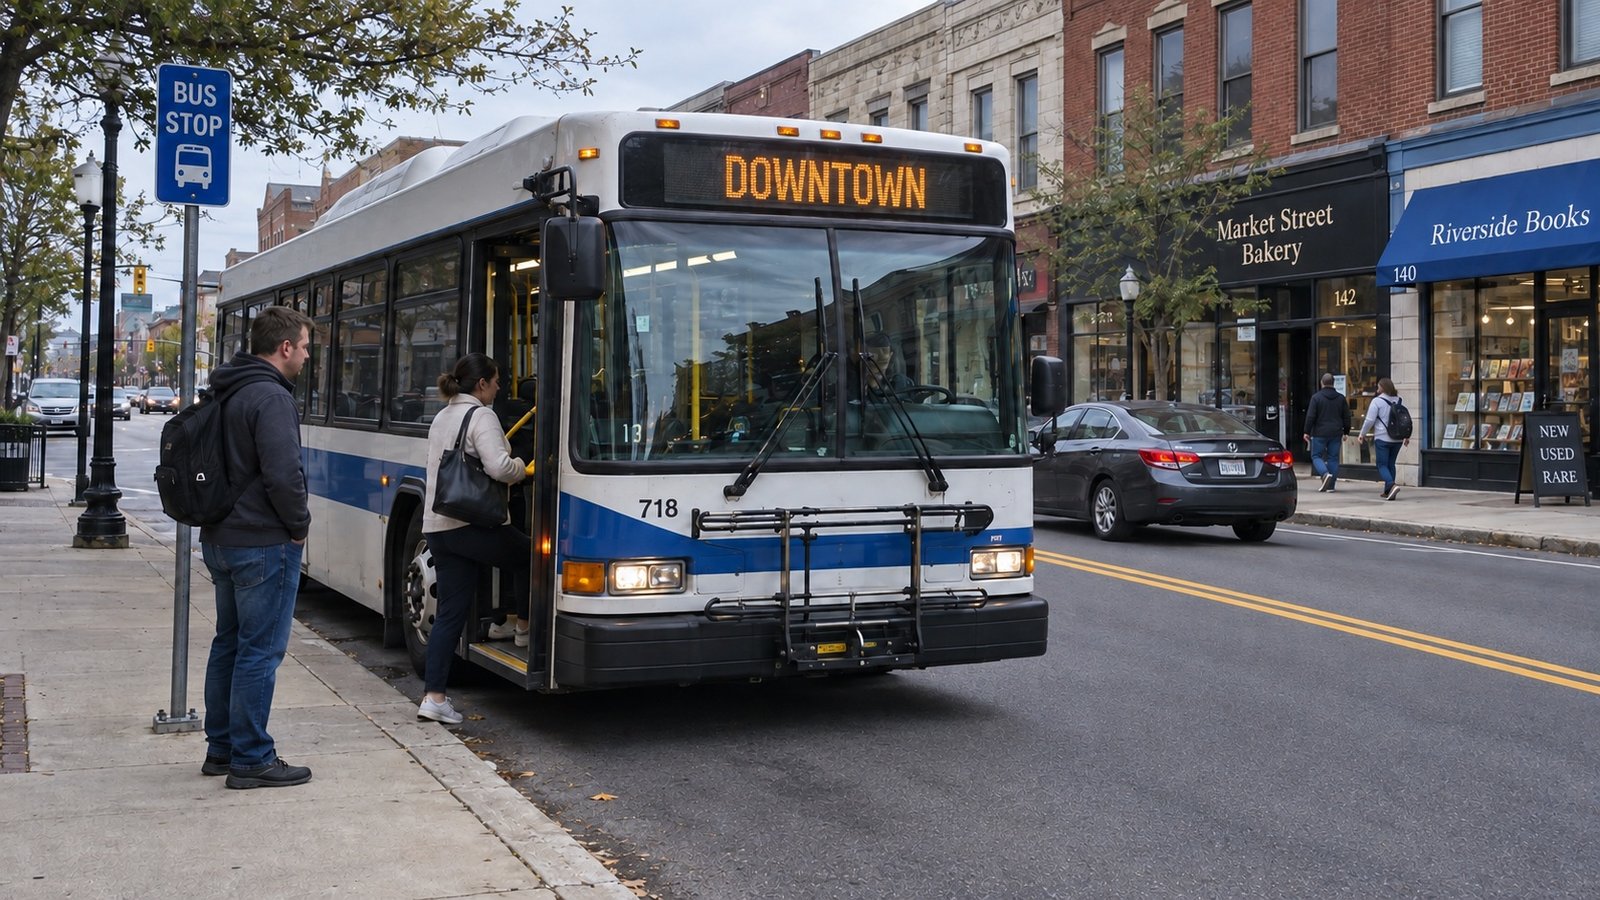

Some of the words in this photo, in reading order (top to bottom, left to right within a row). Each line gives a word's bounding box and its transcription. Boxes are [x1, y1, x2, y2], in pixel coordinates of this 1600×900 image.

[174, 81, 217, 107] BUS
[166, 111, 223, 137] STOP
[724, 154, 927, 209] DOWNTOWN
[1216, 214, 1276, 242] Market
[1280, 203, 1334, 232] Street
[1430, 214, 1519, 246] Riverside
[1523, 203, 1591, 234] Books
[1241, 239, 1303, 266] Bakery
[1393, 265, 1417, 283] 140
[1334, 288, 1357, 307] 142
[1539, 424, 1570, 438] NEW
[1540, 447, 1575, 461] USED
[1542, 470, 1578, 484] RARE
[638, 498, 678, 519] 718
